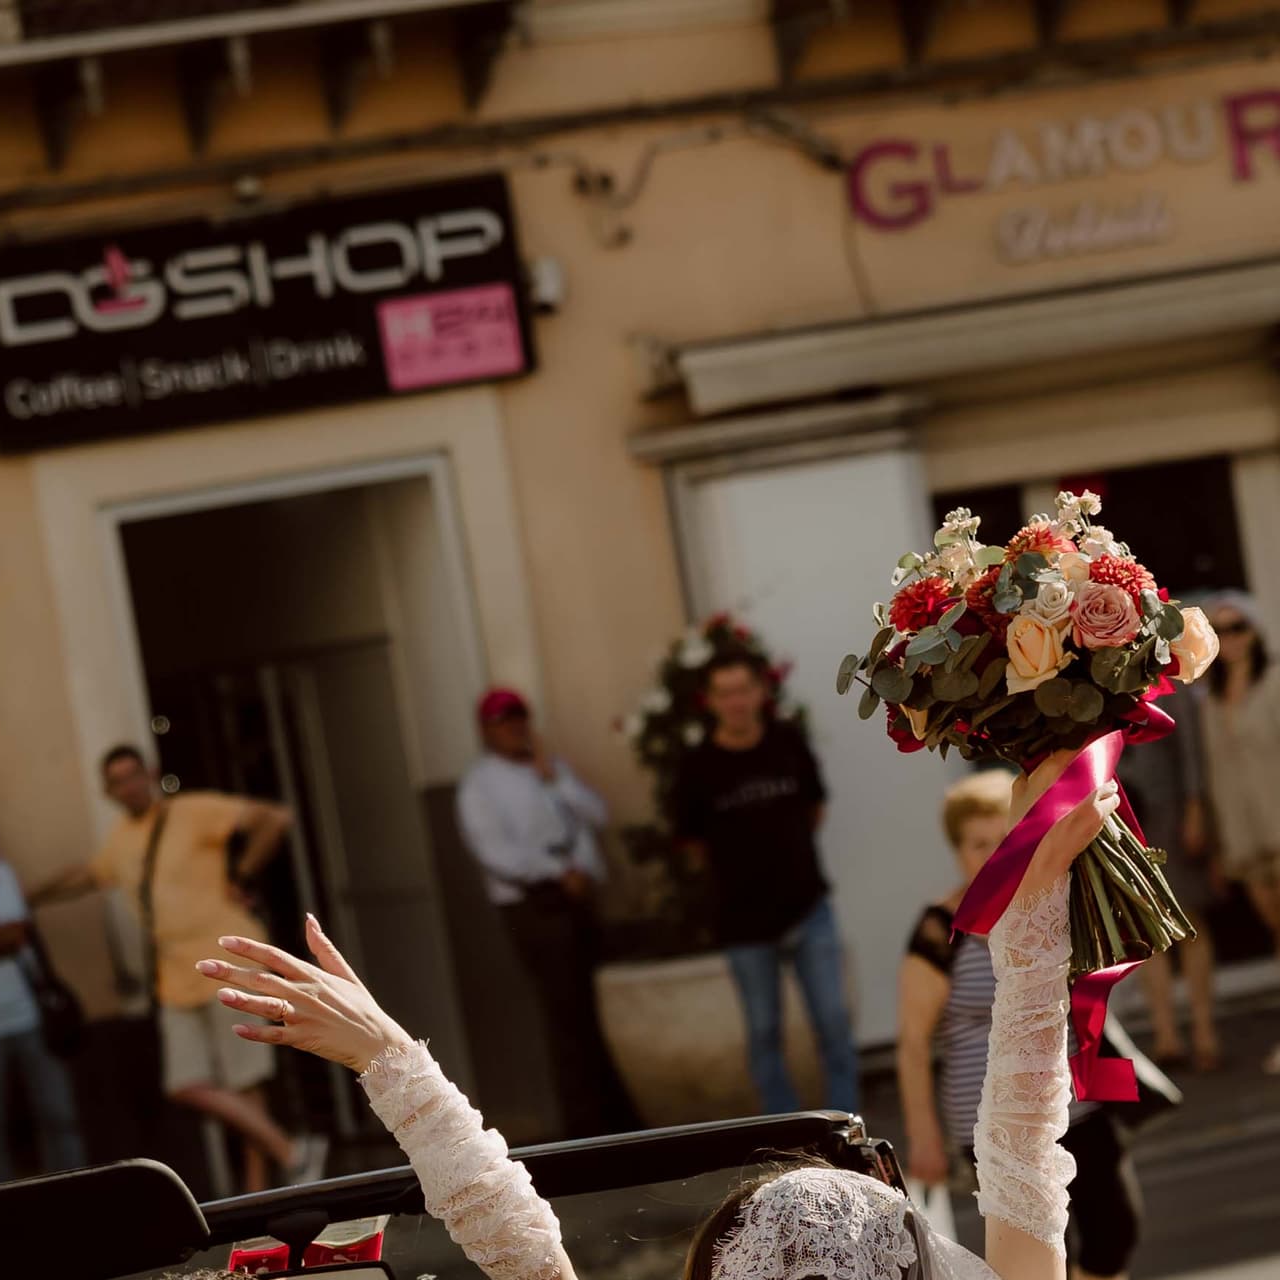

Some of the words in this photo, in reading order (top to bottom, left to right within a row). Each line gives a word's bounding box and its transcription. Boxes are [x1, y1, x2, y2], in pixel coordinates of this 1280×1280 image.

[6, 372, 122, 420] Coffee
[144, 347, 252, 397] Snack
[269, 332, 366, 378] Drink
